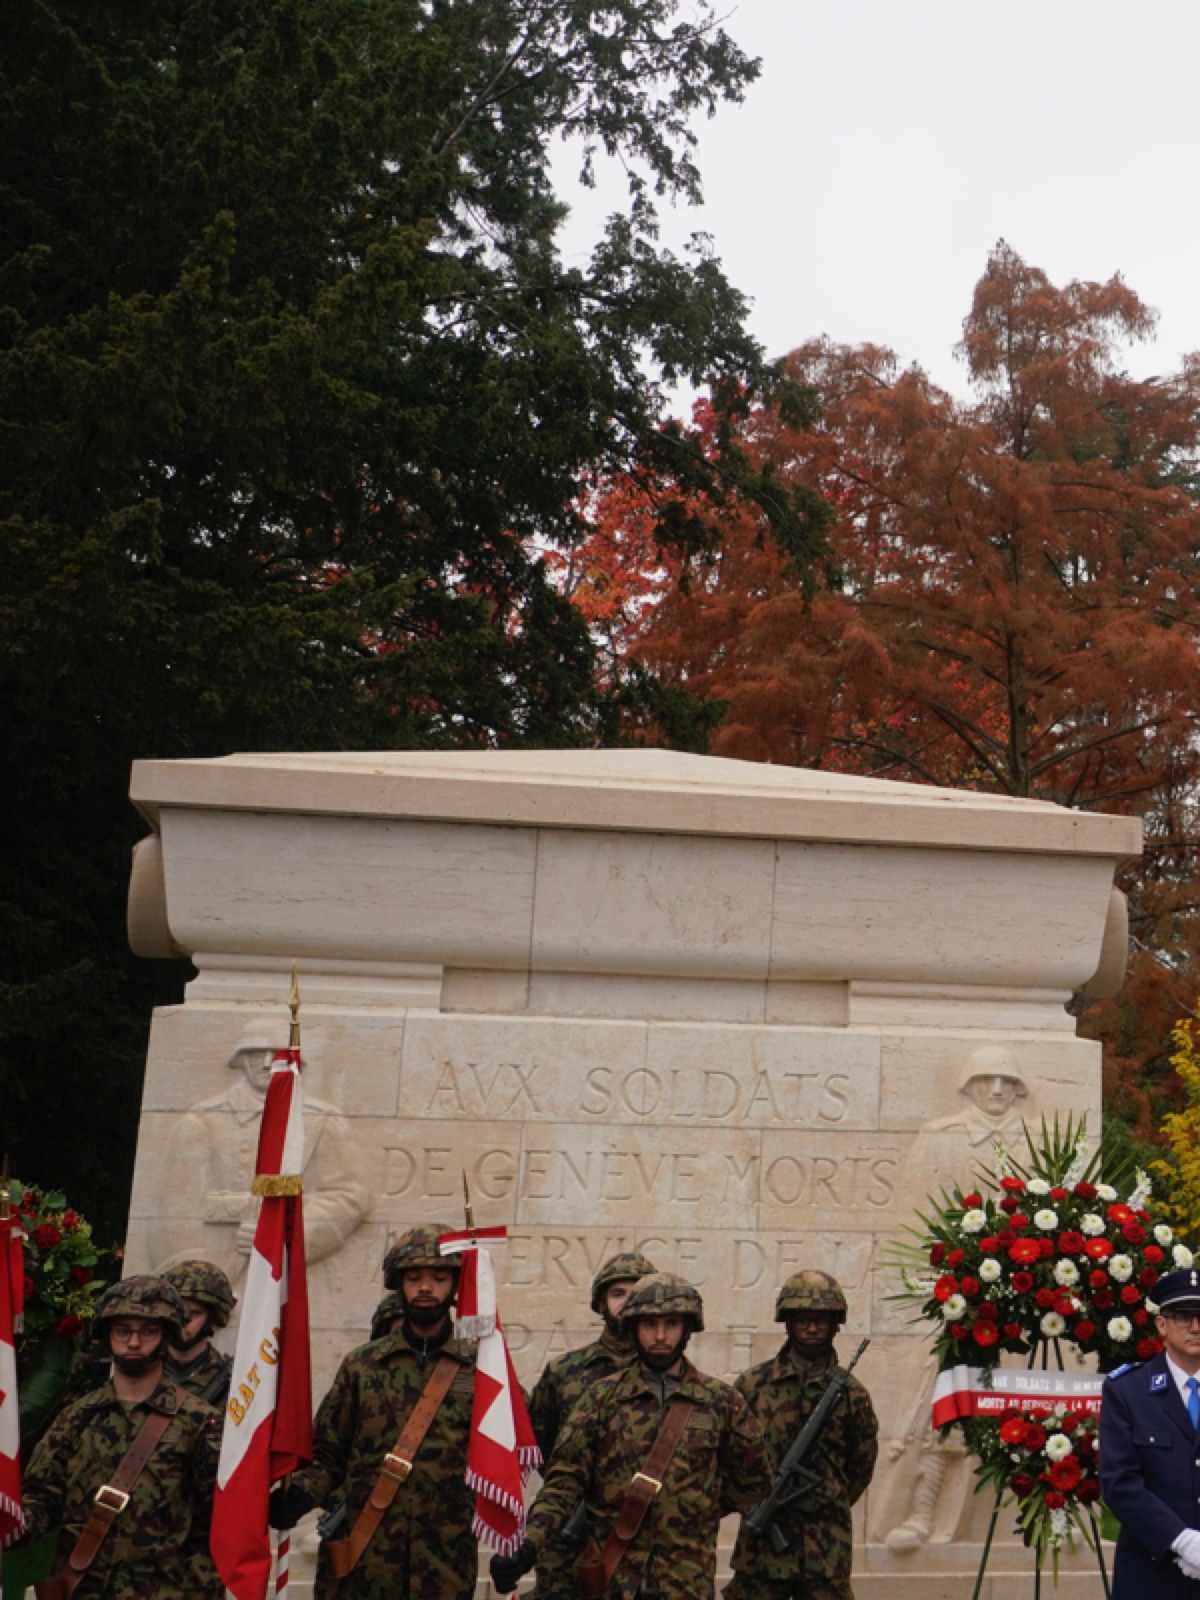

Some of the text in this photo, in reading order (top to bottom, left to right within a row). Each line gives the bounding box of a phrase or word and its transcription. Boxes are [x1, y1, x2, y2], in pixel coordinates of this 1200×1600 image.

[426, 1060, 851, 1123] AVX SOLDATS
[382, 1141, 898, 1208] DE GENÈVE MORTS
[227, 1361, 261, 1427] BAT
[977, 1396, 1006, 1409] MORTS
